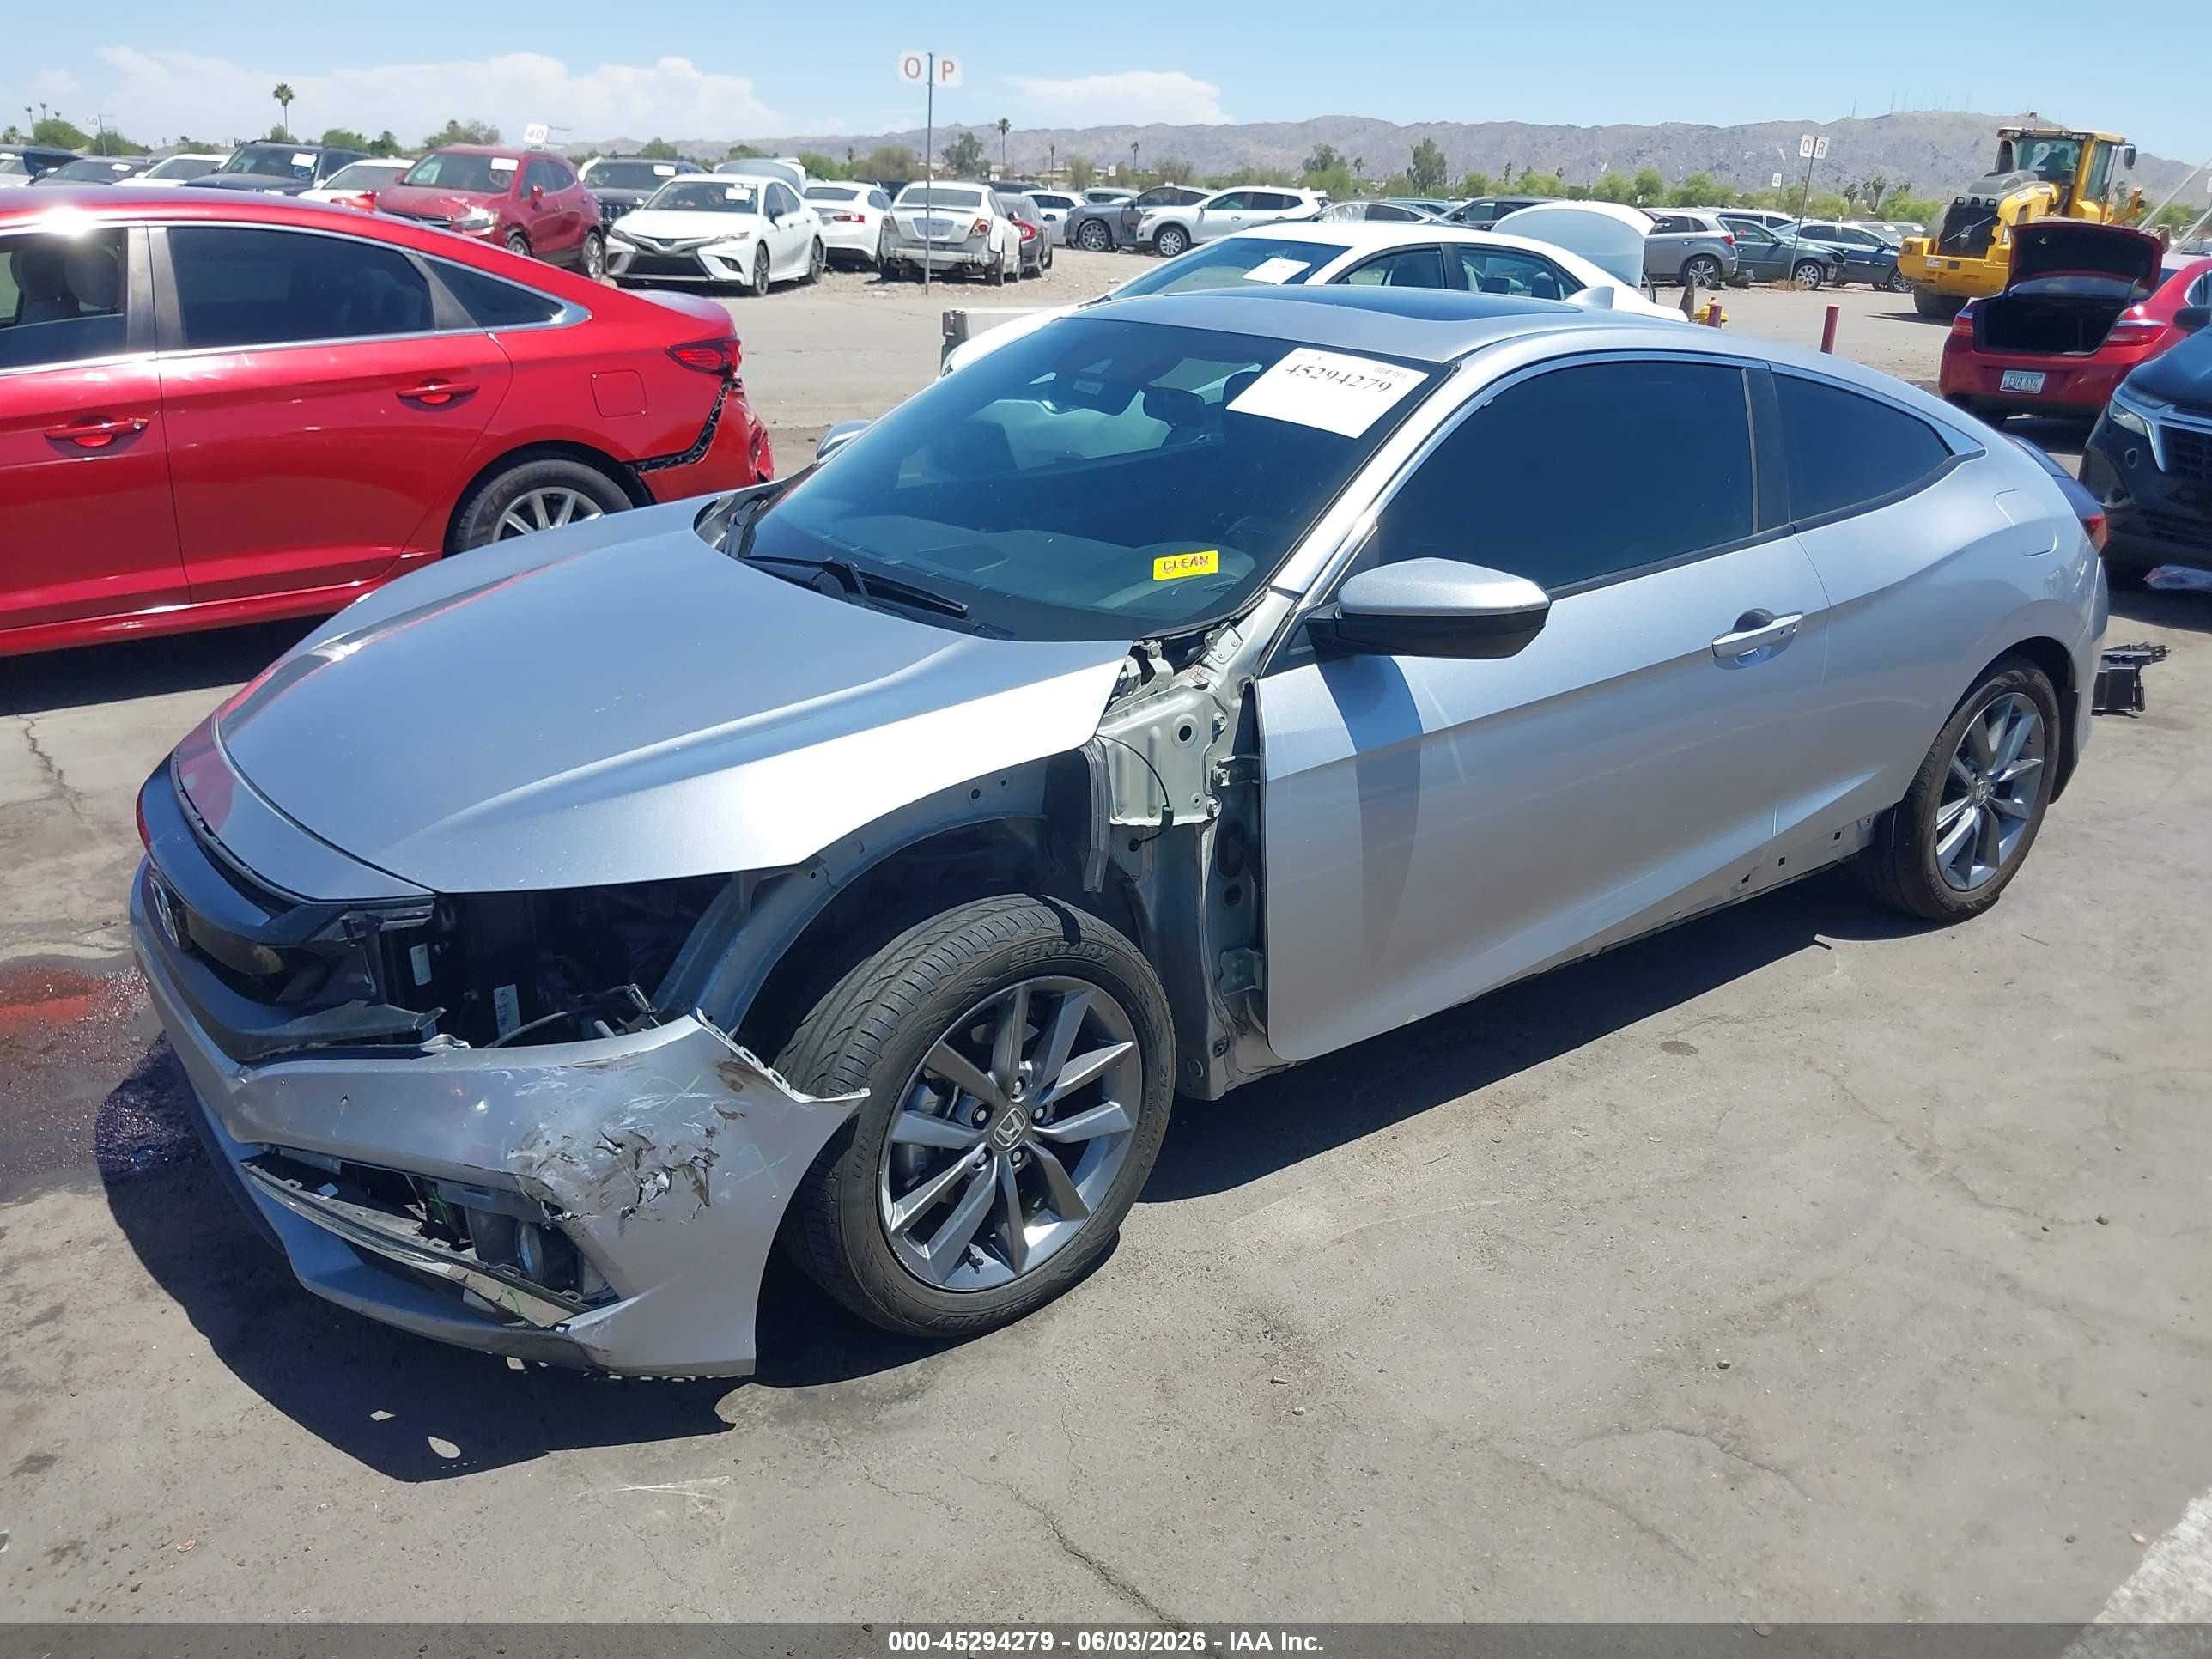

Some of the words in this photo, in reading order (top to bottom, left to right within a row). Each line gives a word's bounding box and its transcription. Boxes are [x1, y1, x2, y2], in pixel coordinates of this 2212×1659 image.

[904, 57, 921, 79] O
[942, 60, 955, 81] P
[1802, 139, 1811, 153] Q
[1817, 142, 1826, 154] R
[1286, 364, 1392, 392] 45294279
[1163, 555, 1209, 572] CLEAN
